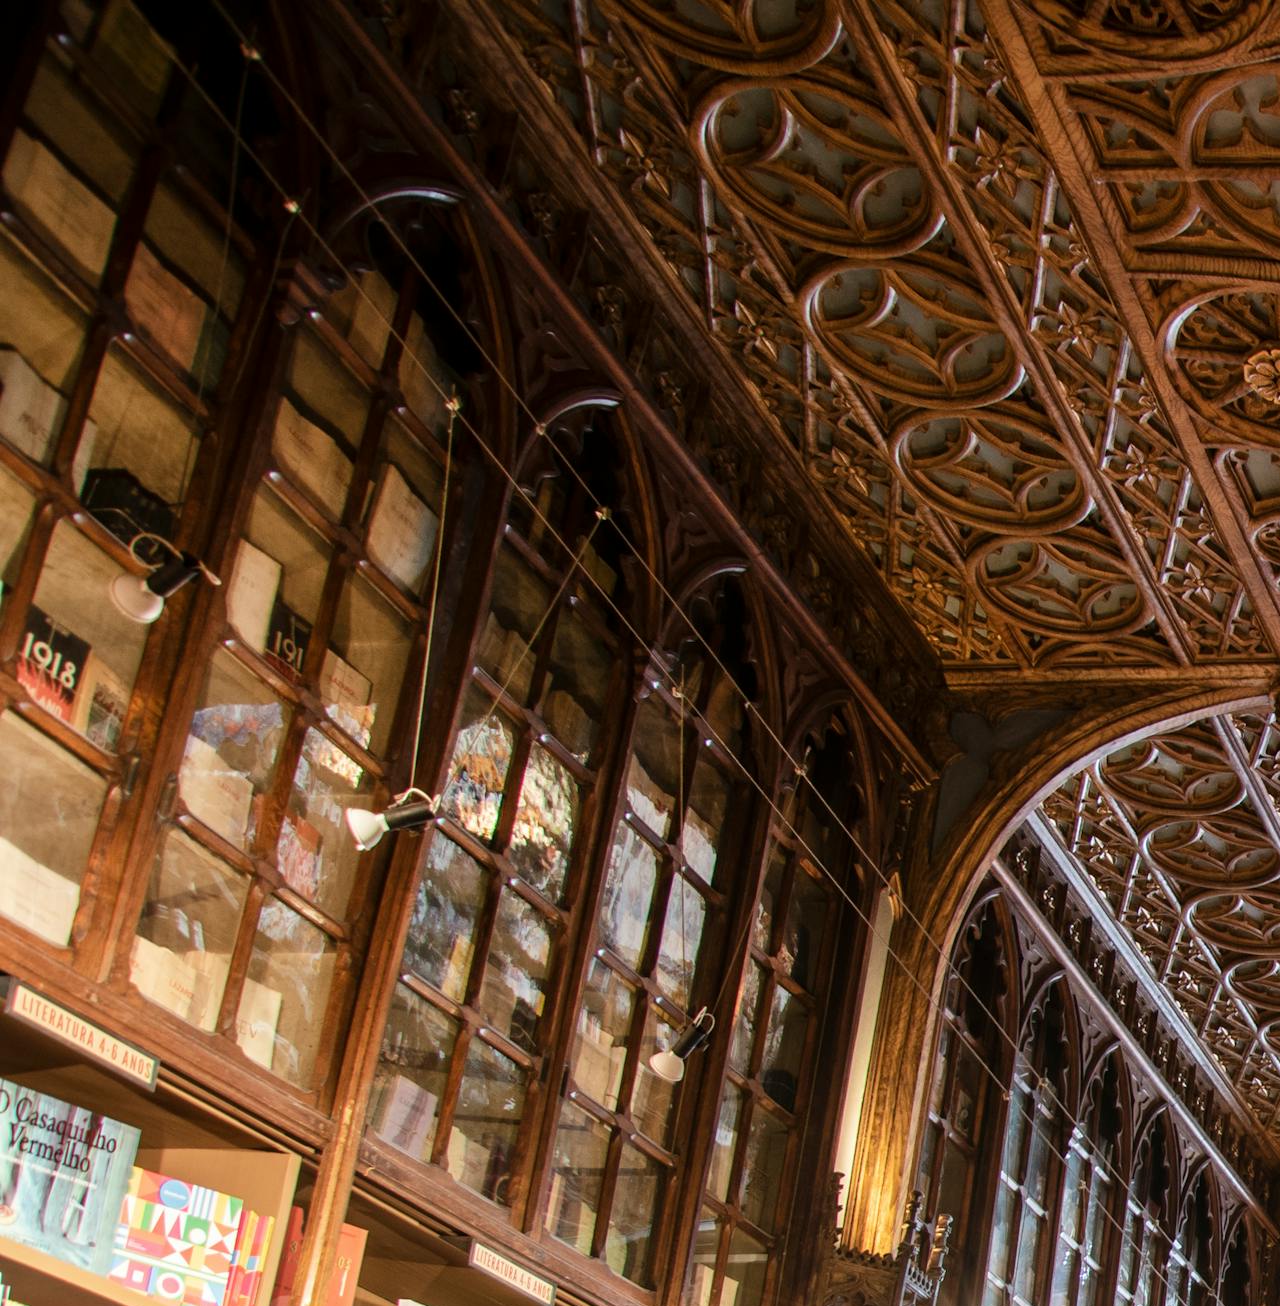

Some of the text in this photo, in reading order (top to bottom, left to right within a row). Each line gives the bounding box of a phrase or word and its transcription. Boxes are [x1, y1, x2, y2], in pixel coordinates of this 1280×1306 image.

[23, 632, 77, 690] 1918
[22, 992, 94, 1047] LITERATURA
[121, 1050, 153, 1079] ANOS
[9, 1121, 91, 1174] Vermelho
[15, 1095, 118, 1154] Casaquinho
[475, 1247, 519, 1282] LITERATURA
[531, 1277, 552, 1300] ANOS
